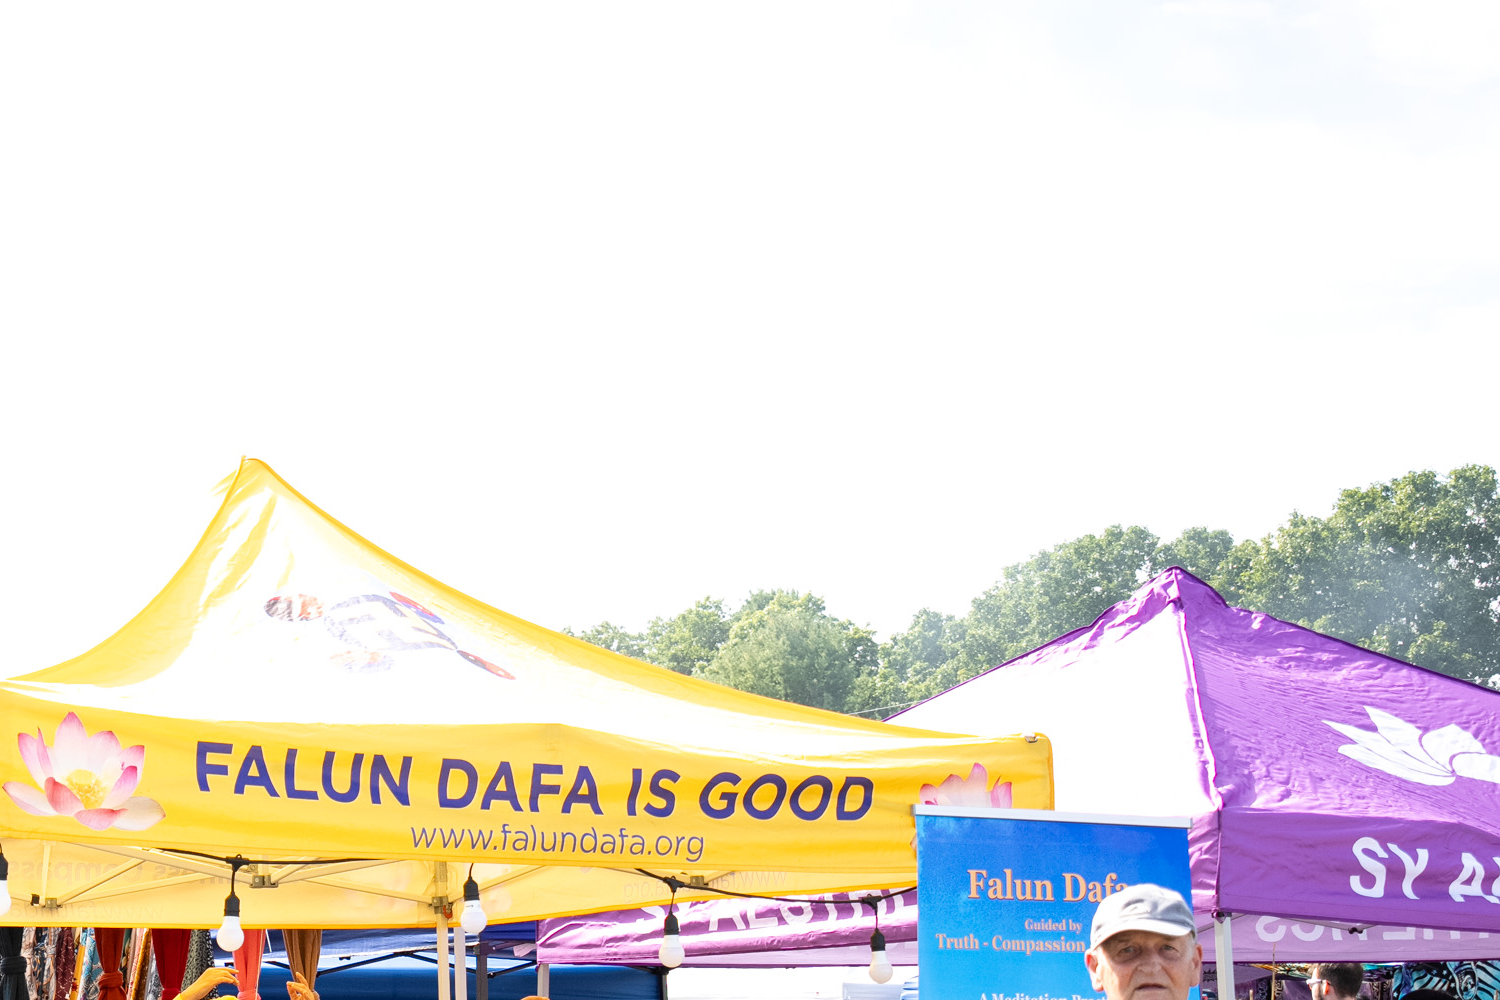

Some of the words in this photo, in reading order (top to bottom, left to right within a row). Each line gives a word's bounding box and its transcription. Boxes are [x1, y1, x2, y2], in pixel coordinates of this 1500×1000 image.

[196, 741, 413, 807] FALUN
[438, 758, 604, 816] DAFA
[627, 768, 681, 818] IS
[699, 772, 874, 822] GOOD
[411, 823, 704, 863] www.falundafa.org
[967, 868, 1055, 902] Falun
[1349, 836, 1429, 900] SY
[1448, 852, 1500, 905] A
[935, 933, 980, 949] Truth
[992, 935, 1086, 955] Compassion
[1024, 918, 1066, 931] Guided
[1068, 919, 1083, 934] by
